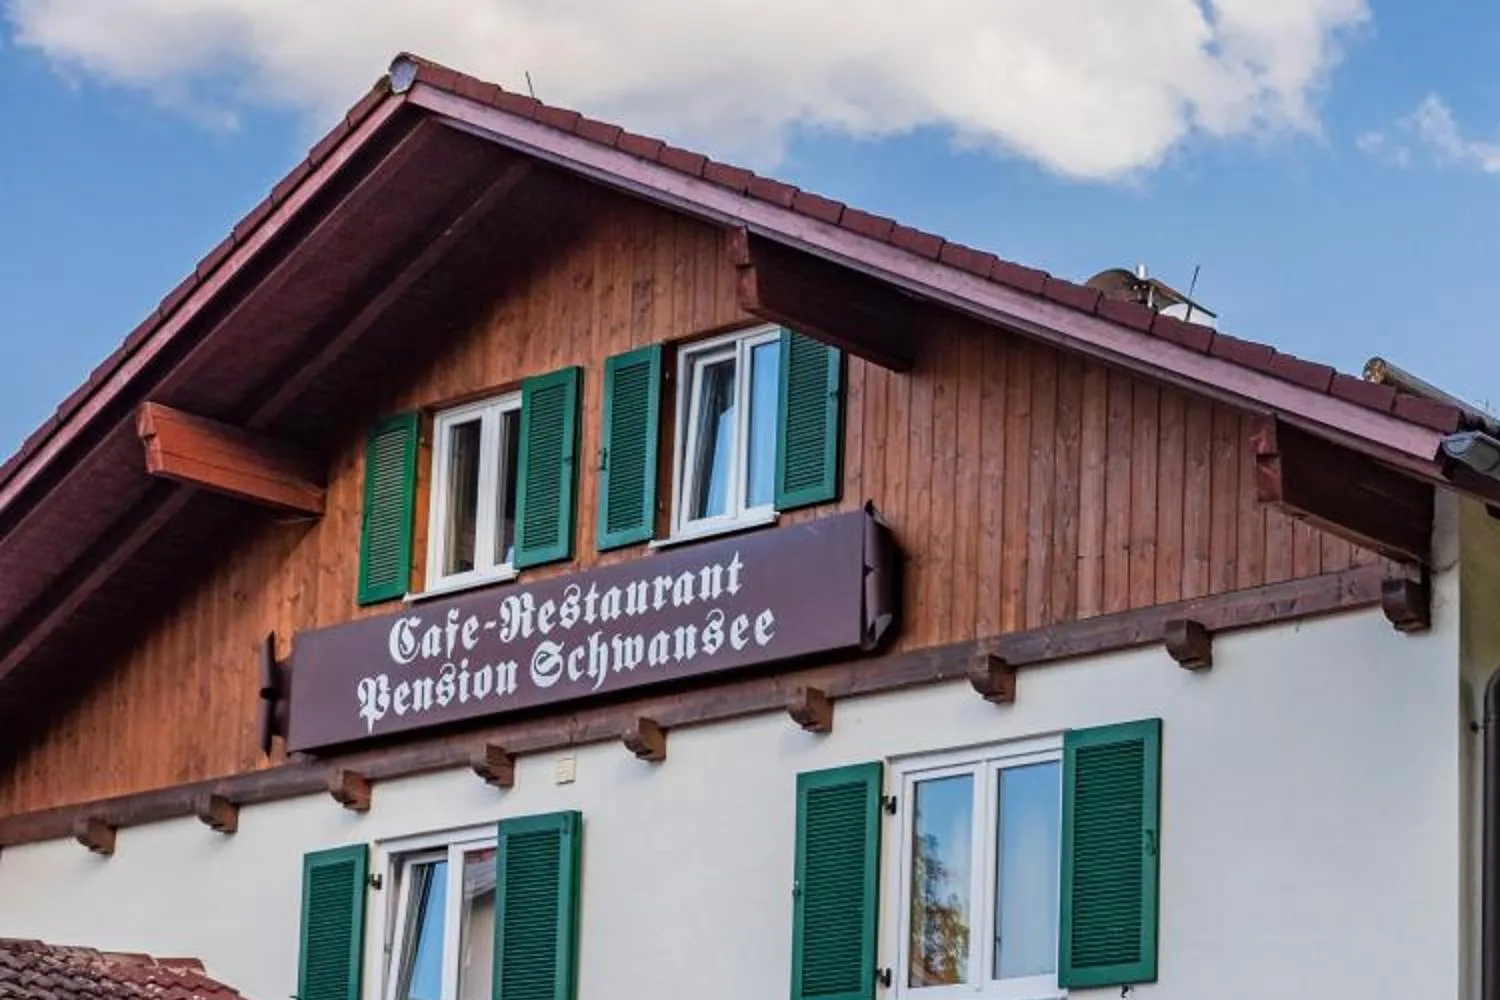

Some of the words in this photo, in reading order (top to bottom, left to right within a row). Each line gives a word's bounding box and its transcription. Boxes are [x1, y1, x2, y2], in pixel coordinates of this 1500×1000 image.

[388, 549, 744, 665] Cafe-Restaurant
[358, 659, 518, 735] Pension
[530, 607, 776, 691] Schwansee
